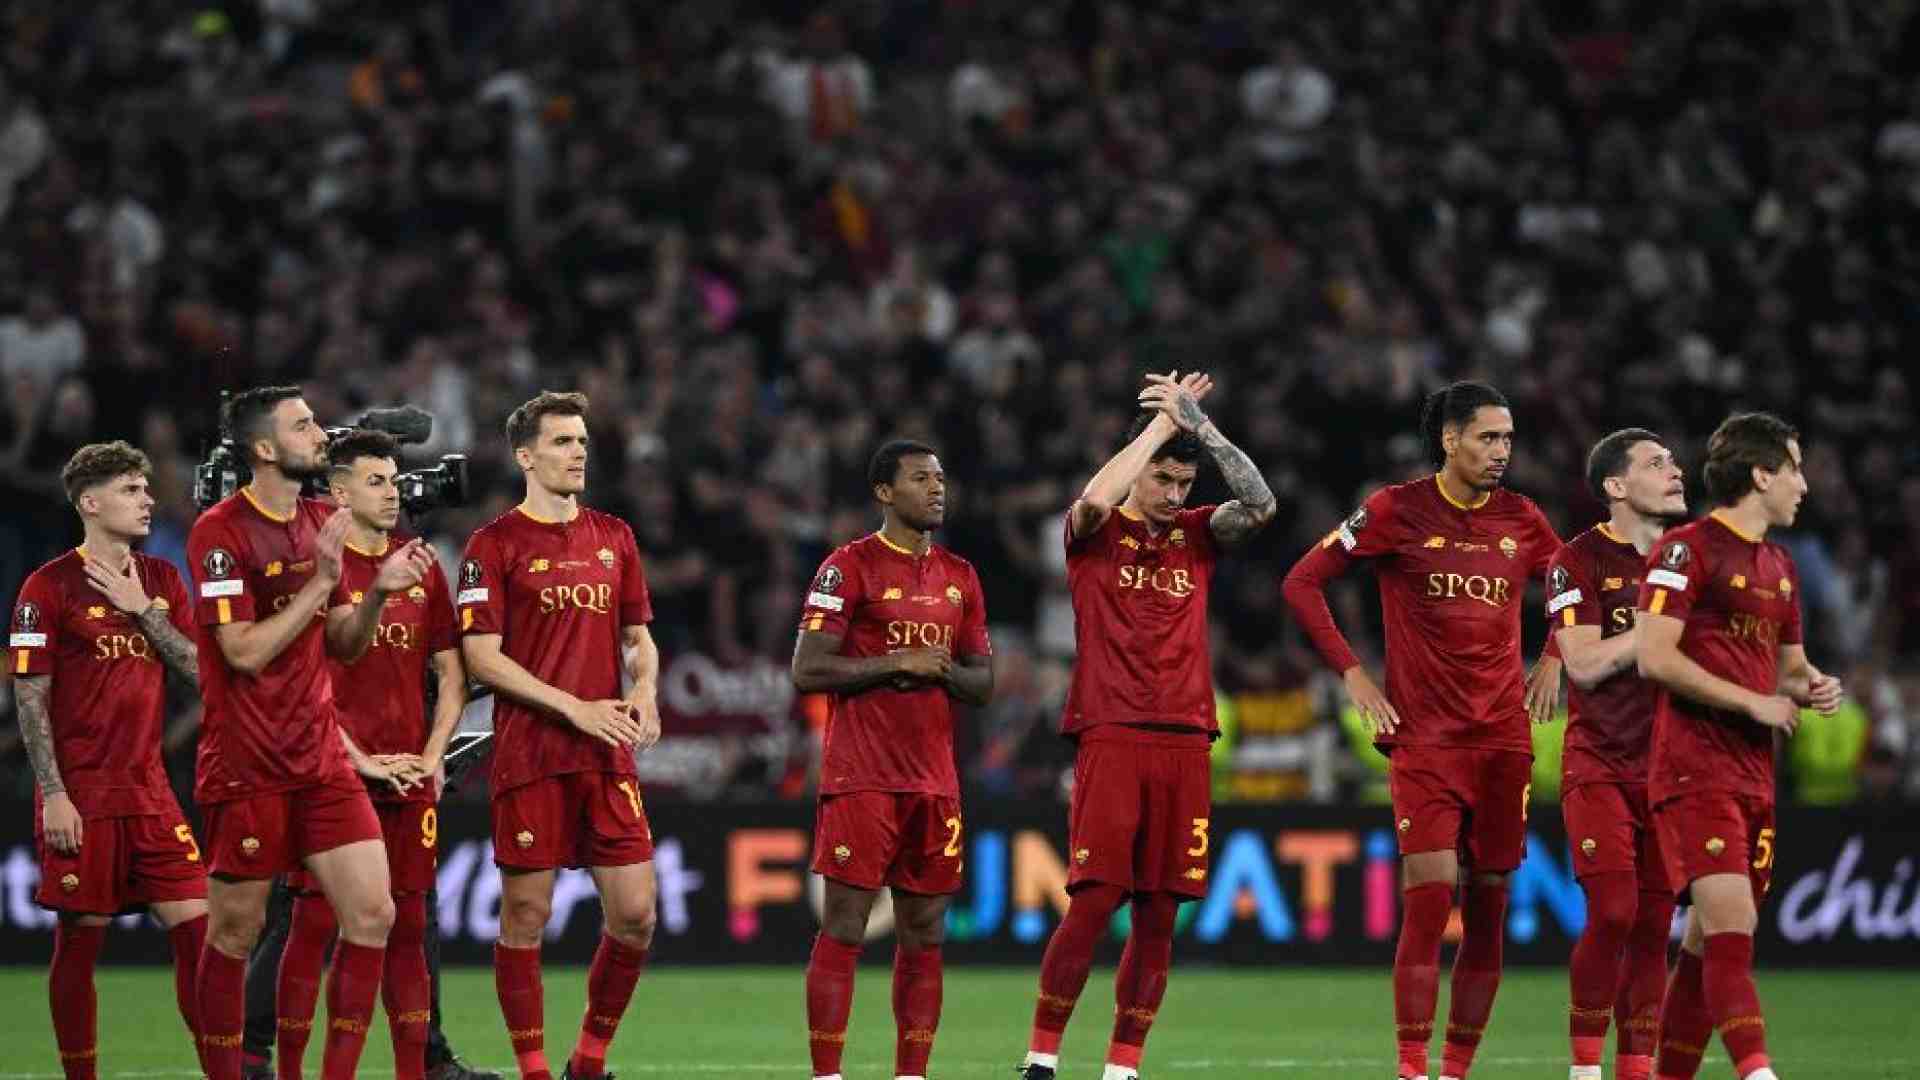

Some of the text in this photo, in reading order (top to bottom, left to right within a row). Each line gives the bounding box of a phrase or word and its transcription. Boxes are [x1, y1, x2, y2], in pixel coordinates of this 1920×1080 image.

[540, 583, 612, 614] SPQR
[1427, 573, 1510, 608] SPQR
[420, 807, 438, 849] 9
[944, 817, 962, 857] 2
[1187, 818, 1209, 857] 3
[1779, 834, 1920, 943] chi
